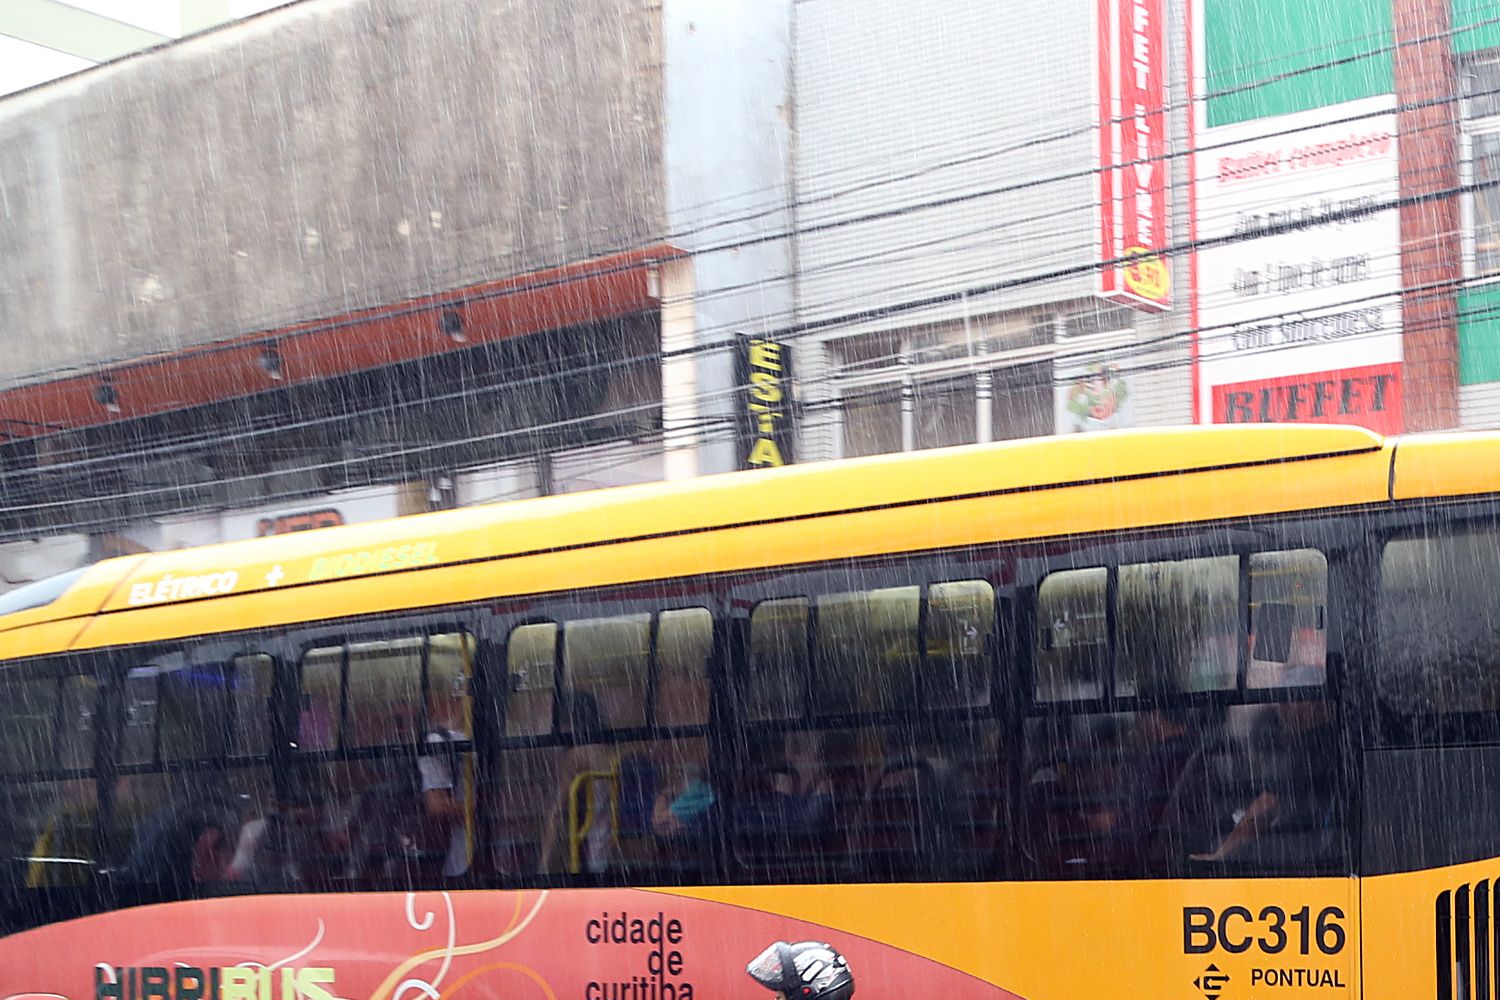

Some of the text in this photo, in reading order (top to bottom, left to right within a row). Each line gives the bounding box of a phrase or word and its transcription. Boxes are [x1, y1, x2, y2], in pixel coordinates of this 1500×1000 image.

[1225, 372, 1397, 424] BUFFET
[127, 570, 239, 606] ELÉTRICO
[308, 541, 440, 581] BIODIESEL
[585, 911, 683, 945] cidade
[1182, 905, 1347, 955] BC316
[648, 950, 684, 976] de
[1251, 968, 1346, 988] PONTUAL
